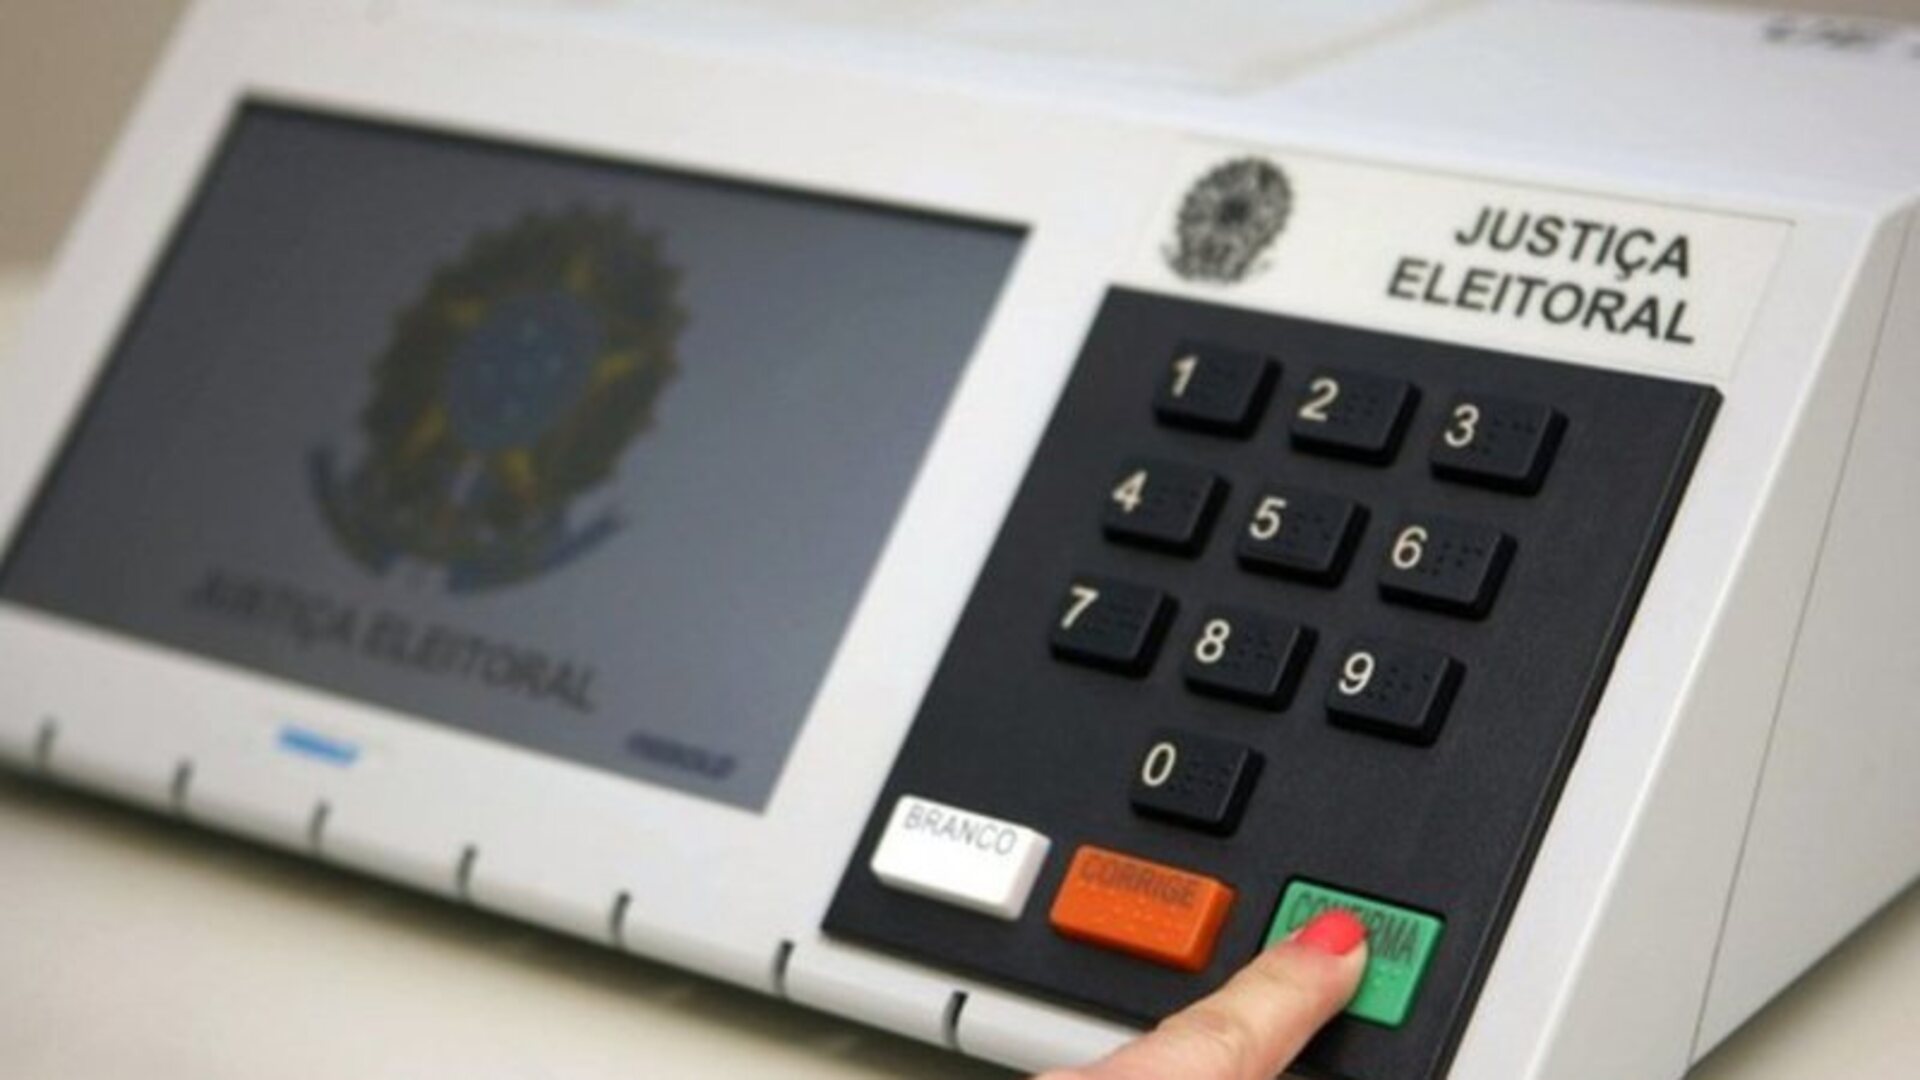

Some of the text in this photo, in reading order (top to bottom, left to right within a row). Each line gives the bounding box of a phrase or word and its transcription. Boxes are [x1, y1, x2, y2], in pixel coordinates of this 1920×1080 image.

[1455, 208, 1690, 281] JUSTIÇA
[1387, 256, 1696, 345] ELEITORAL
[1172, 355, 1197, 397] 1
[1298, 376, 1340, 422] 2
[1443, 403, 1480, 448] 3
[1111, 470, 1148, 513] 4
[1248, 496, 1287, 541] 5
[1391, 525, 1428, 570] 6
[1060, 585, 1099, 629] 7
[361, 614, 597, 714] ELEITORAL
[1194, 618, 1231, 664] 8
[1337, 650, 1376, 696] 9
[1140, 741, 1178, 788] 0
[902, 801, 1018, 856] BRANCO
[1080, 853, 1200, 909] CORRIGE
[1287, 891, 1421, 963] CORMA
